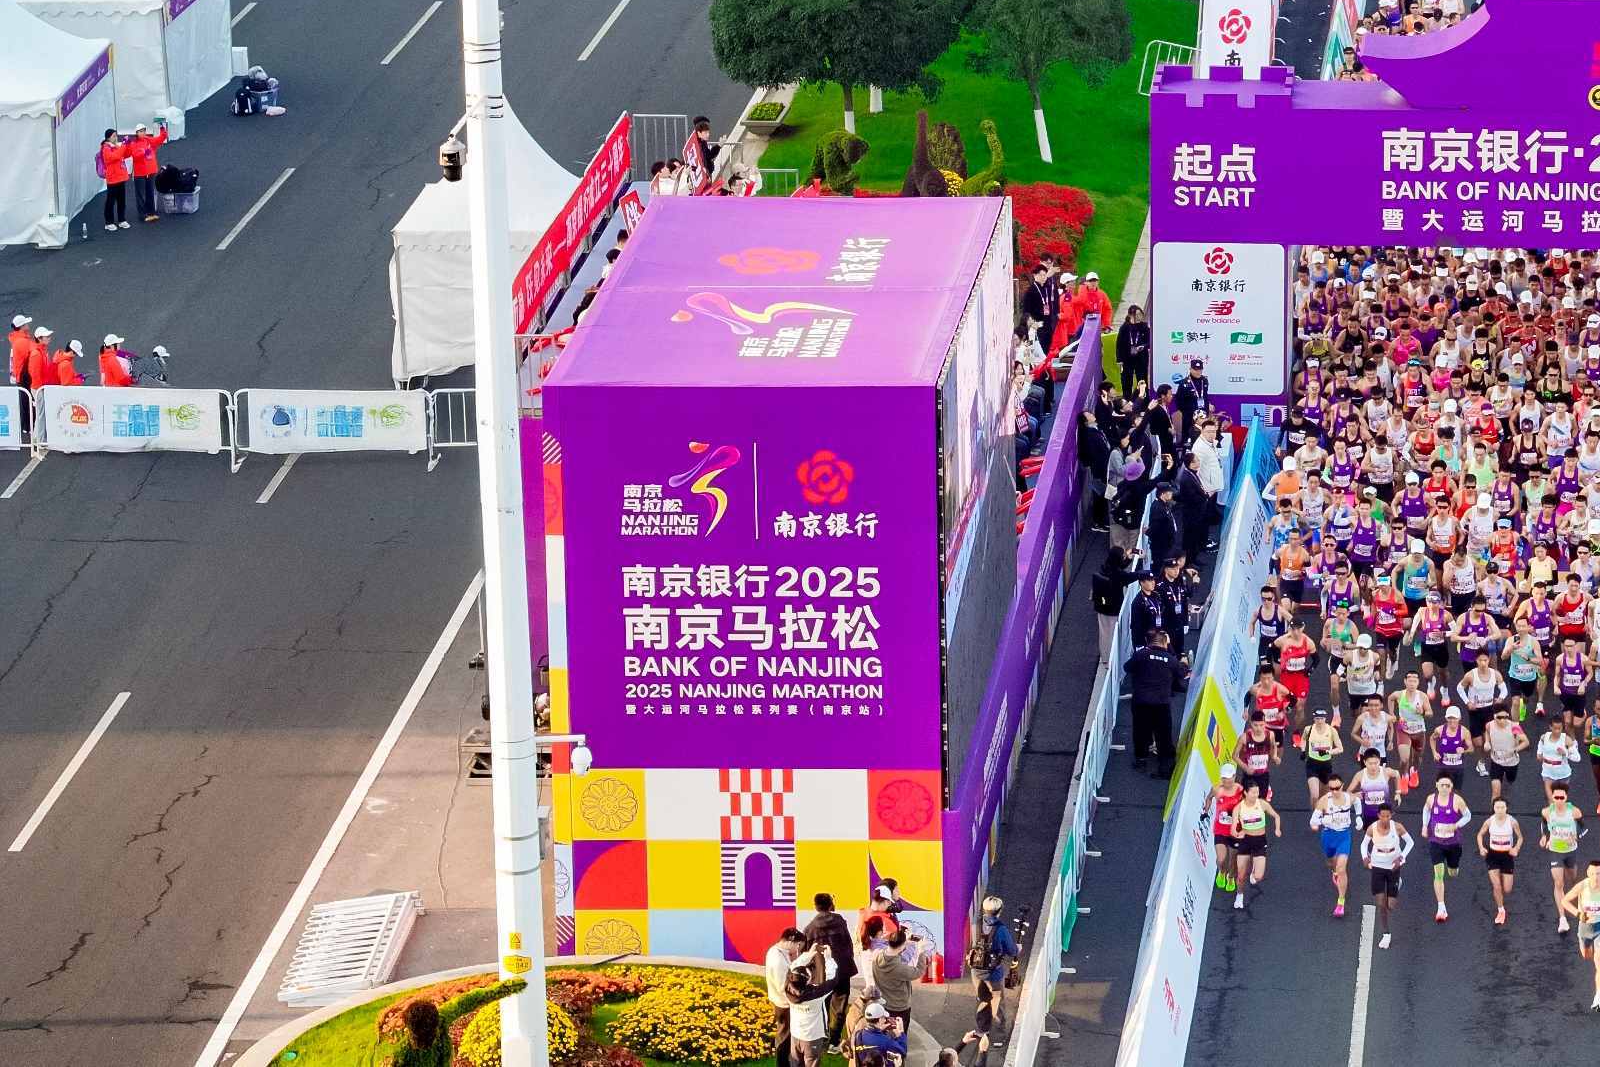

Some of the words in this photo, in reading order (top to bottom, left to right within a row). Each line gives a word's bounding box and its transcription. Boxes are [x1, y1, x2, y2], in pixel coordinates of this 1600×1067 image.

[1172, 143, 1257, 183] 起点
[1173, 187, 1256, 208] START
[1381, 181, 1448, 200] BANK
[1456, 182, 1489, 201] OF
[1191, 278, 1246, 293] 南京银行
[797, 318, 834, 358] NANJING
[1186, 332, 1211, 343] 蒙牛
[623, 484, 663, 498] 南京
[622, 498, 683, 513] 马拉松
[621, 515, 698, 526] NANJING
[773, 511, 879, 539] 南京银行
[620, 526, 698, 536] MARATHON
[622, 603, 881, 651] 南京马拉松
[624, 656, 699, 677] BANK
[710, 656, 747, 677] OF
[758, 657, 883, 678] NANJING
[625, 684, 672, 698] 2025
[679, 684, 765, 698] NANJING
[772, 684, 883, 699] MARATHON
